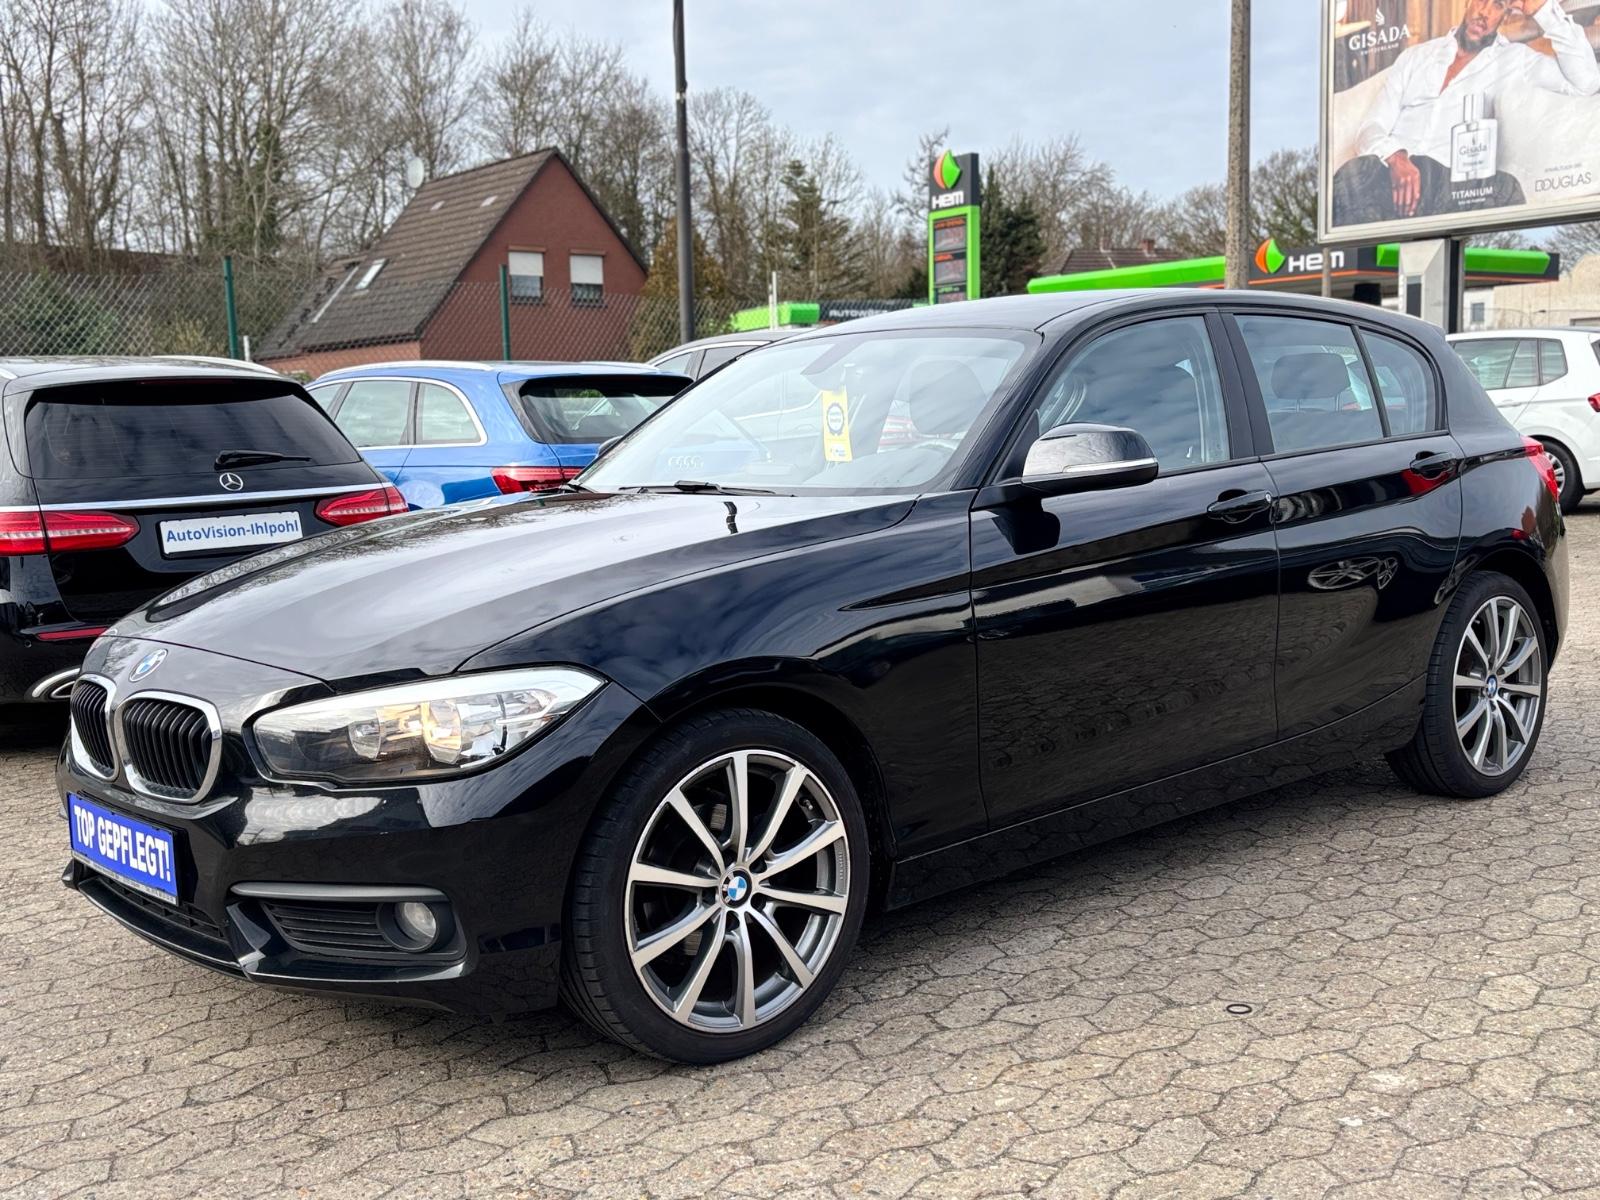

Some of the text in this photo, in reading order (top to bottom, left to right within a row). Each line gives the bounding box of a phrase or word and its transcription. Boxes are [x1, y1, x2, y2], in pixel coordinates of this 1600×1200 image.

[1349, 24, 1410, 50] GISADA
[1452, 187, 1493, 199] TITANIUM
[1535, 172, 1591, 192] DOUGLAS
[167, 520, 299, 542] AutoVision-Ihlpohl
[74, 805, 95, 848] TOP
[97, 816, 171, 881] GEPFLEGT!
